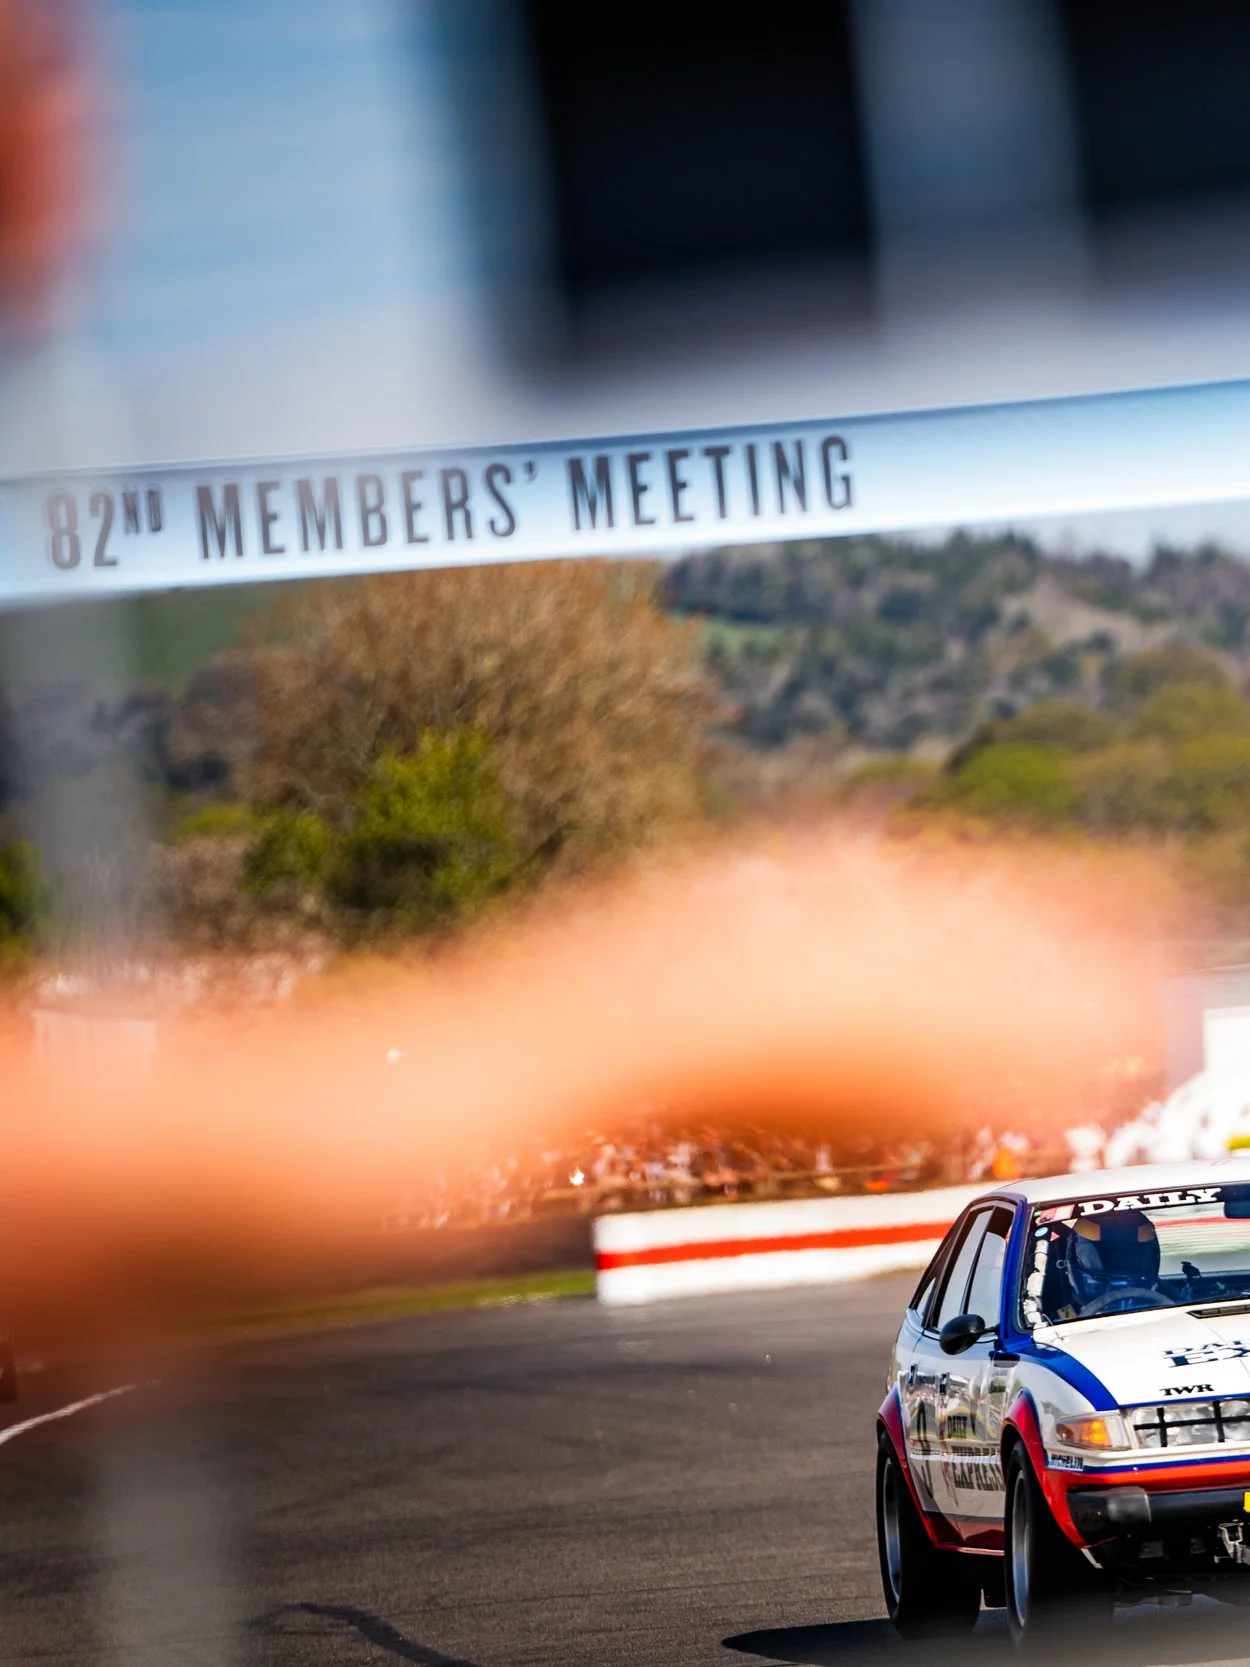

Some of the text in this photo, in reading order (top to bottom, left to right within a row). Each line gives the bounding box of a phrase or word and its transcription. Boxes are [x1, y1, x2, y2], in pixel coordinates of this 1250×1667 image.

[567, 434, 856, 533] MEETING
[1078, 1187, 1222, 1217] DAILY
[1159, 1383, 1215, 1397] TWR
